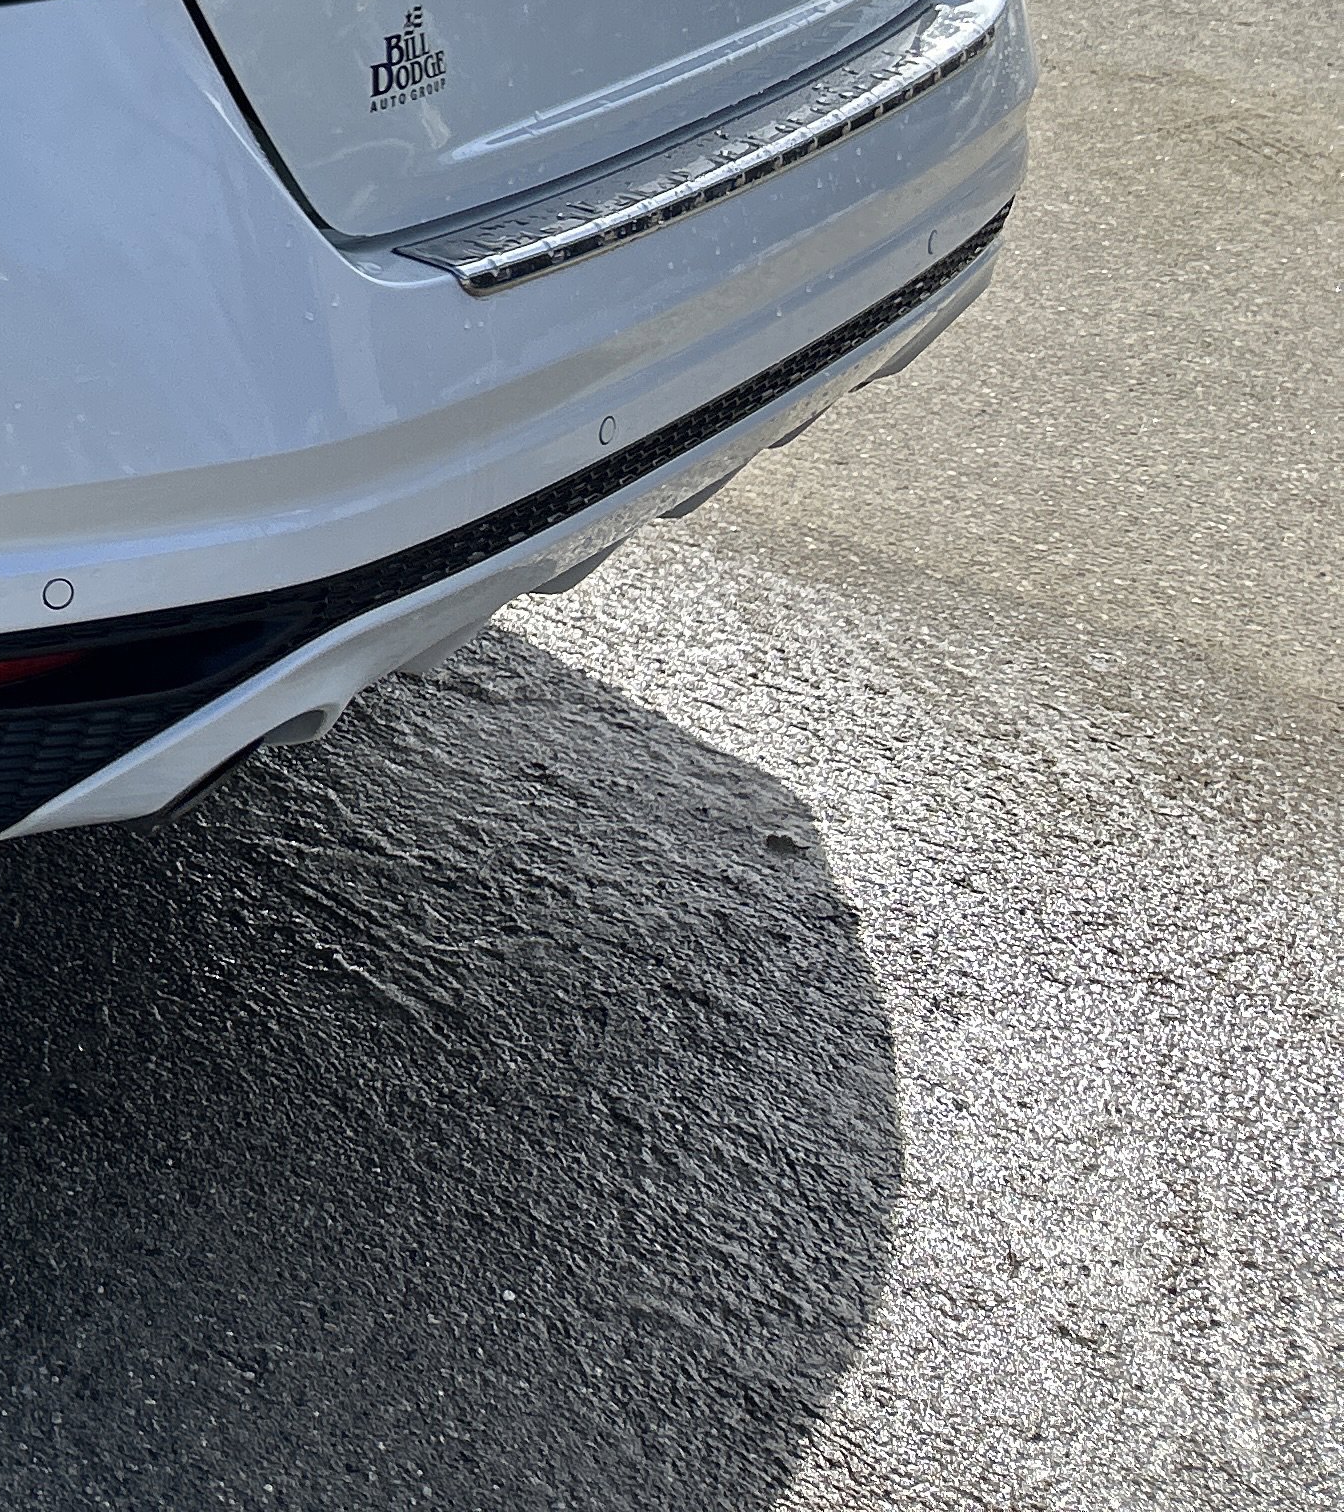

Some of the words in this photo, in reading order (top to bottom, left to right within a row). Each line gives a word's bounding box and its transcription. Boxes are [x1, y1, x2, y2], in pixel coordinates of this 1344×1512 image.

[384, 32, 429, 67] BILL
[370, 50, 447, 97] DODGE
[370, 93, 406, 113] AUTO
[410, 78, 446, 101] GROUP
